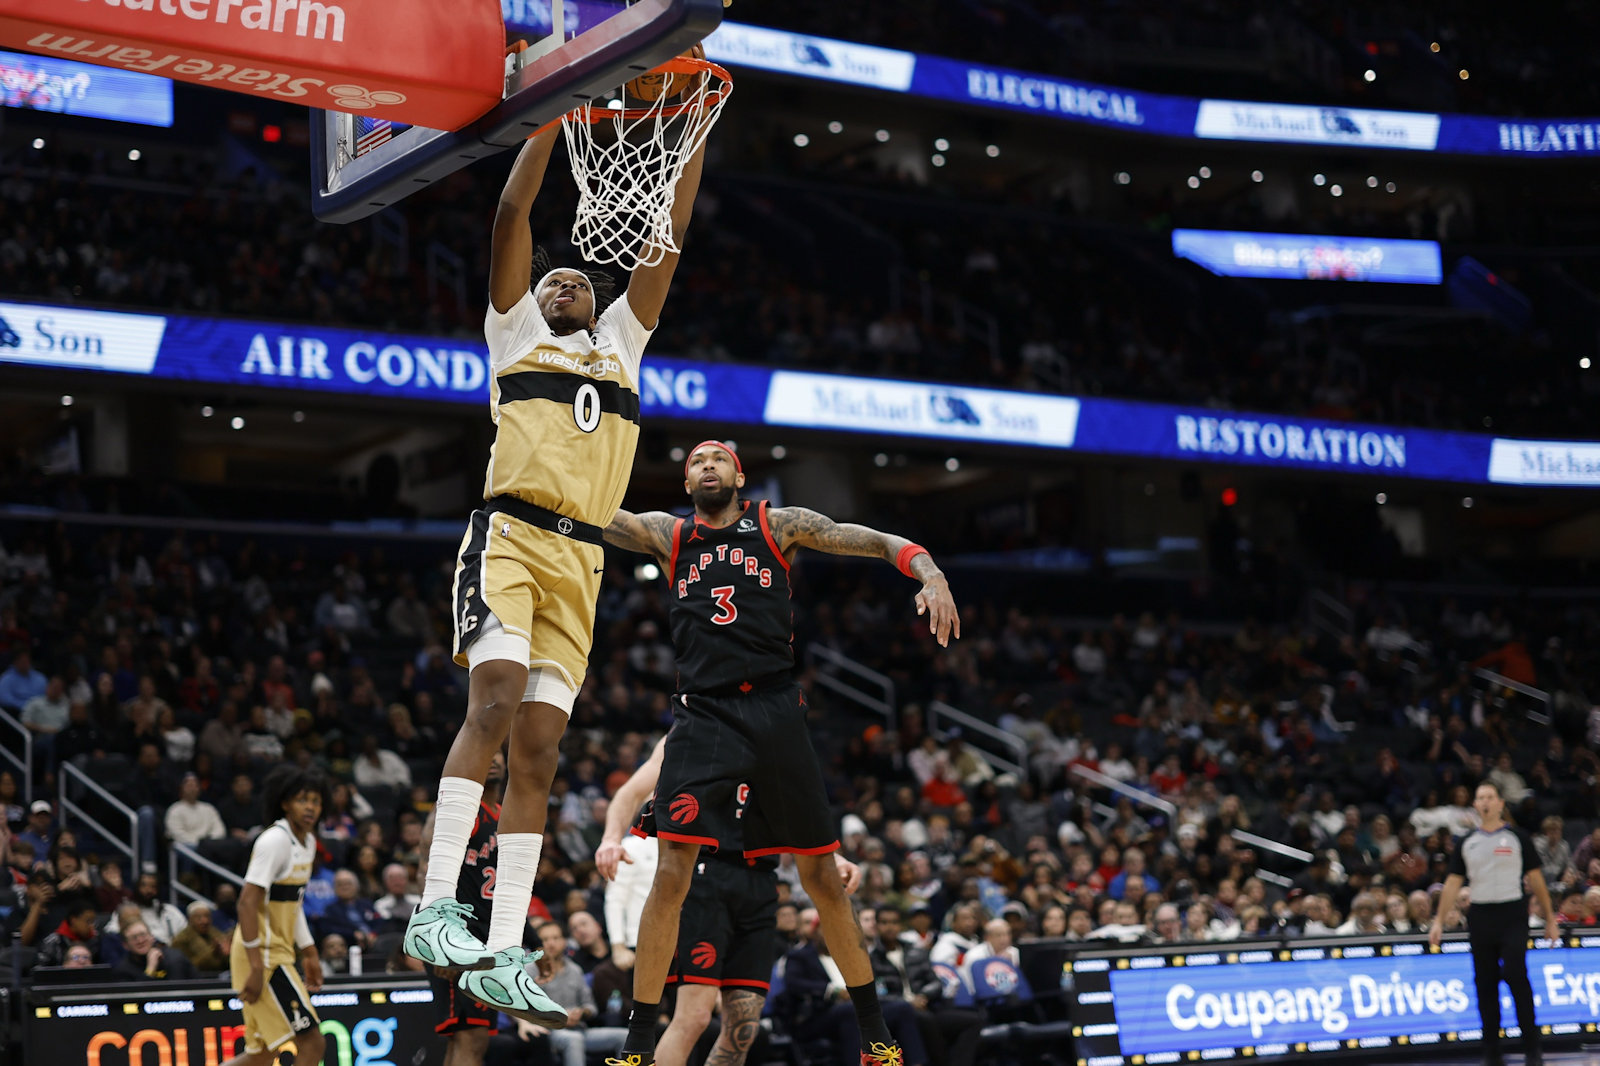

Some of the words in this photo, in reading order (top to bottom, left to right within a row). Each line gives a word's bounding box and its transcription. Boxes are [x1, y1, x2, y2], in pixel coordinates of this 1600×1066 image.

[967, 69, 1144, 125] ELECTRICAL
[34, 314, 104, 356] Son
[240, 333, 334, 381] AIR
[573, 383, 602, 433] 0
[811, 384, 921, 425] Michael
[989, 398, 1040, 433] Son
[1176, 415, 1406, 468] RESTORATION
[678, 543, 772, 599] RAPTORS
[710, 585, 738, 625] 3
[1166, 983, 1349, 1037] Coupang
[1349, 971, 1470, 1018] Drives
